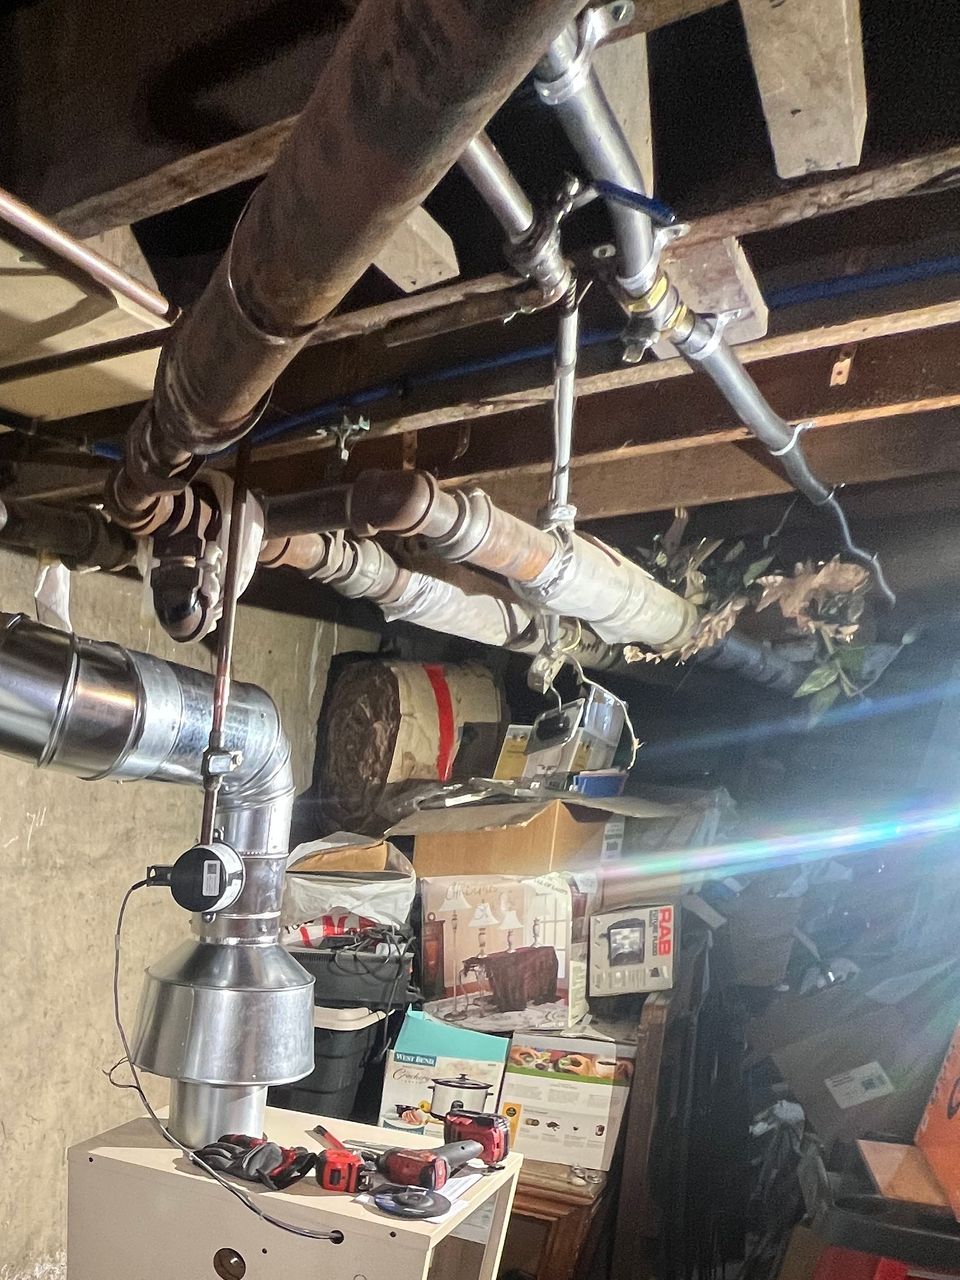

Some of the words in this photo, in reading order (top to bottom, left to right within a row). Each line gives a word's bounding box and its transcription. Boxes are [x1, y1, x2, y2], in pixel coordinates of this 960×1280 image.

[658, 907, 672, 957] RAB
[396, 1053, 415, 1063] WEST
[415, 1055, 435, 1066] BEND
